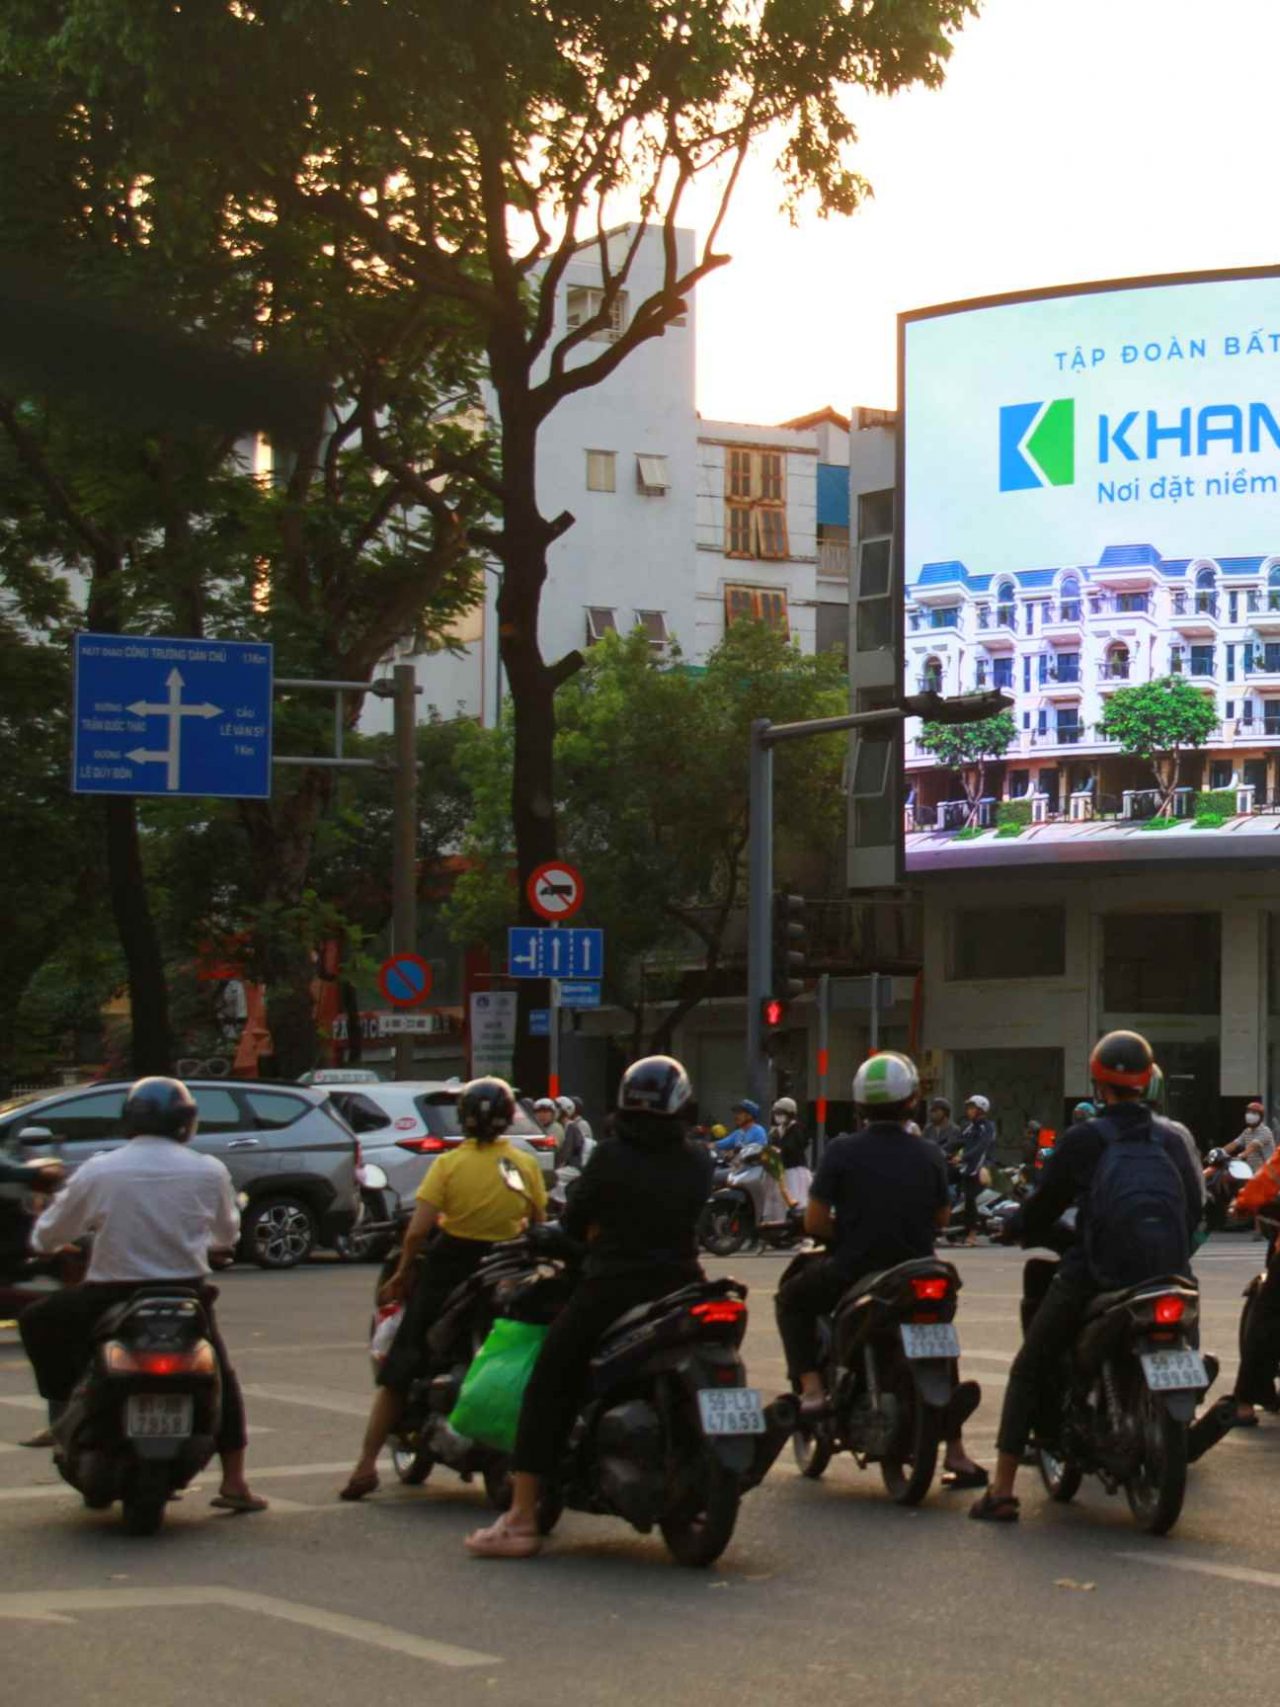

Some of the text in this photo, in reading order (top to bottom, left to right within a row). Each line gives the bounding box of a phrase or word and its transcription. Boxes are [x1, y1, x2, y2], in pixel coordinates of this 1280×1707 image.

[1055, 346, 1105, 373] TẬP
[1122, 337, 1205, 363] ĐOÀN
[1099, 478, 1138, 502] Nơi
[1150, 476, 1194, 503] đặt
[1206, 469, 1276, 495] niềm
